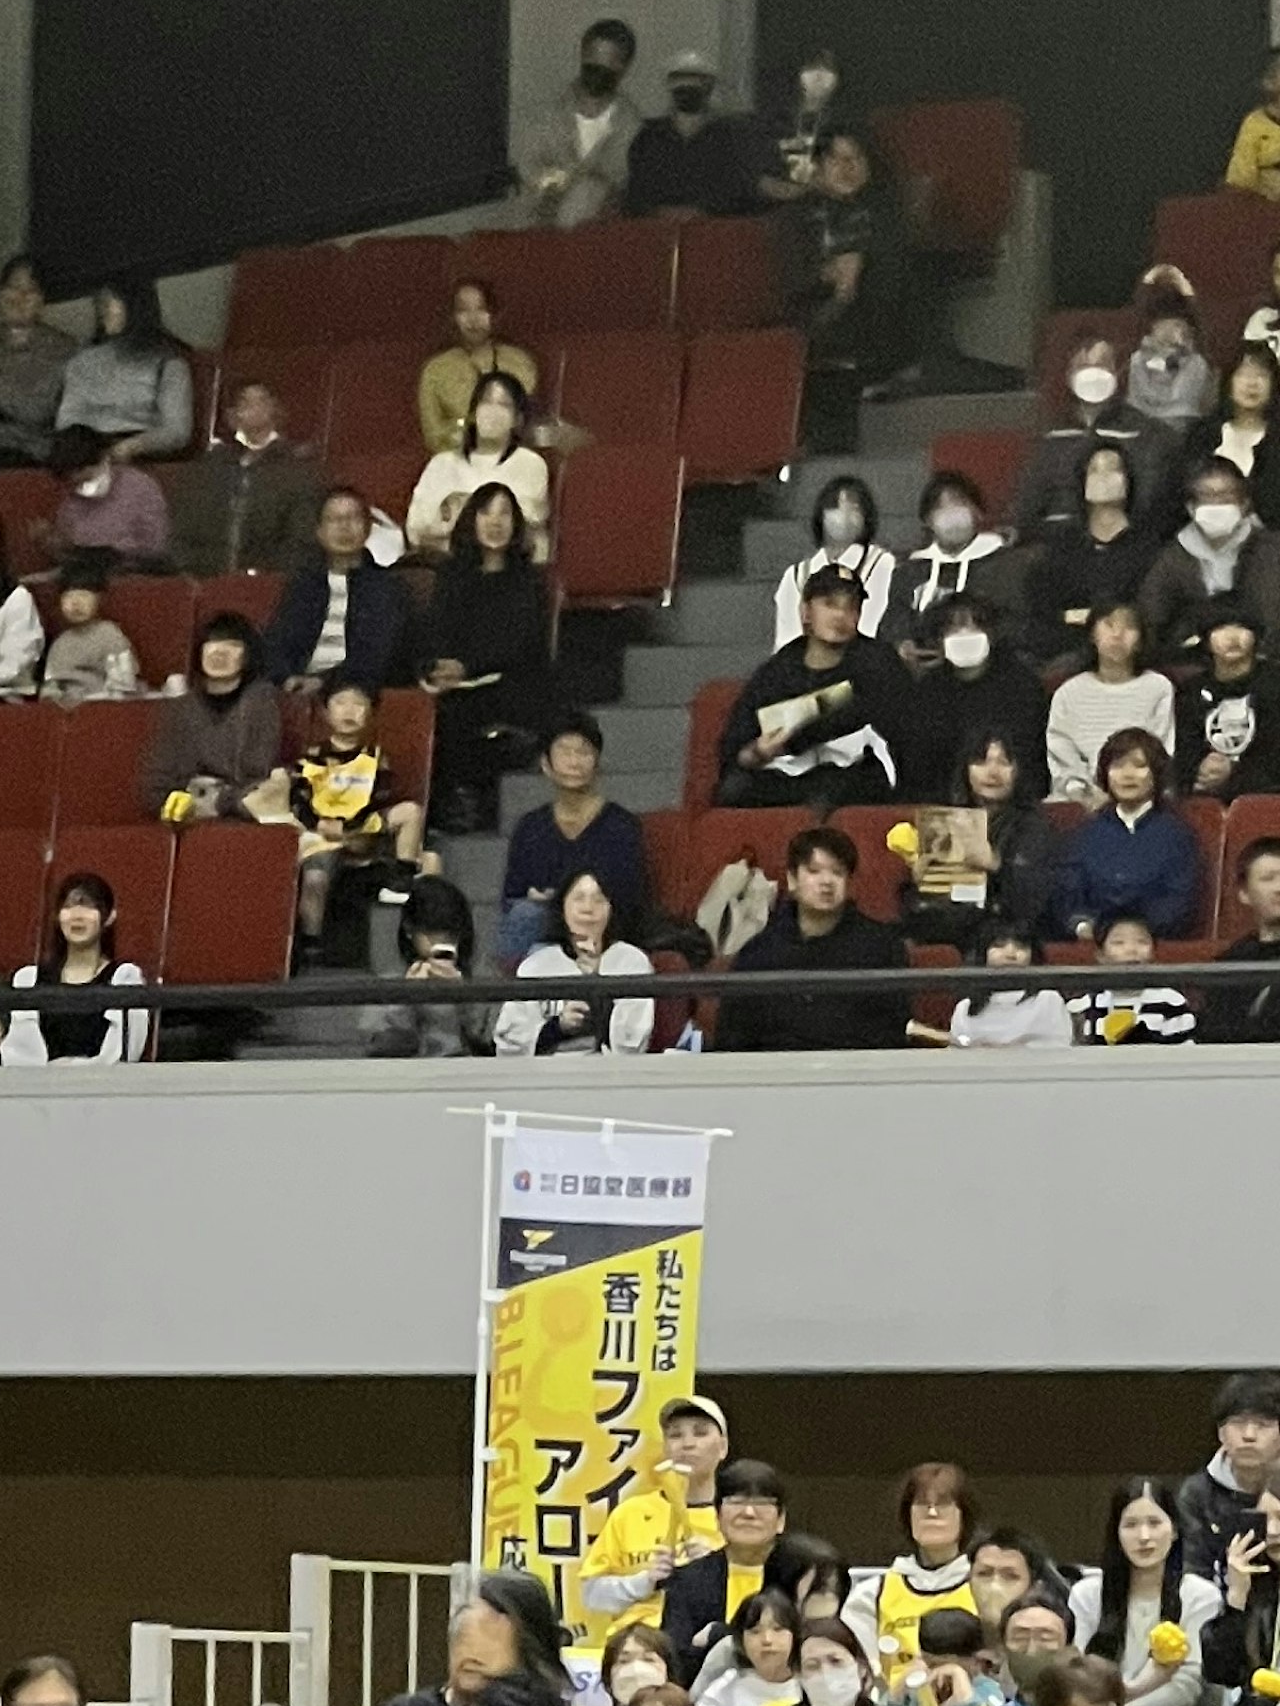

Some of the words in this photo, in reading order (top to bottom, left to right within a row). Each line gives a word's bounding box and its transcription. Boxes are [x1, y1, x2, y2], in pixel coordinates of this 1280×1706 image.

[586, 1272, 642, 1545] 香川ファイ
[652, 1248, 683, 1372] 私たちは
